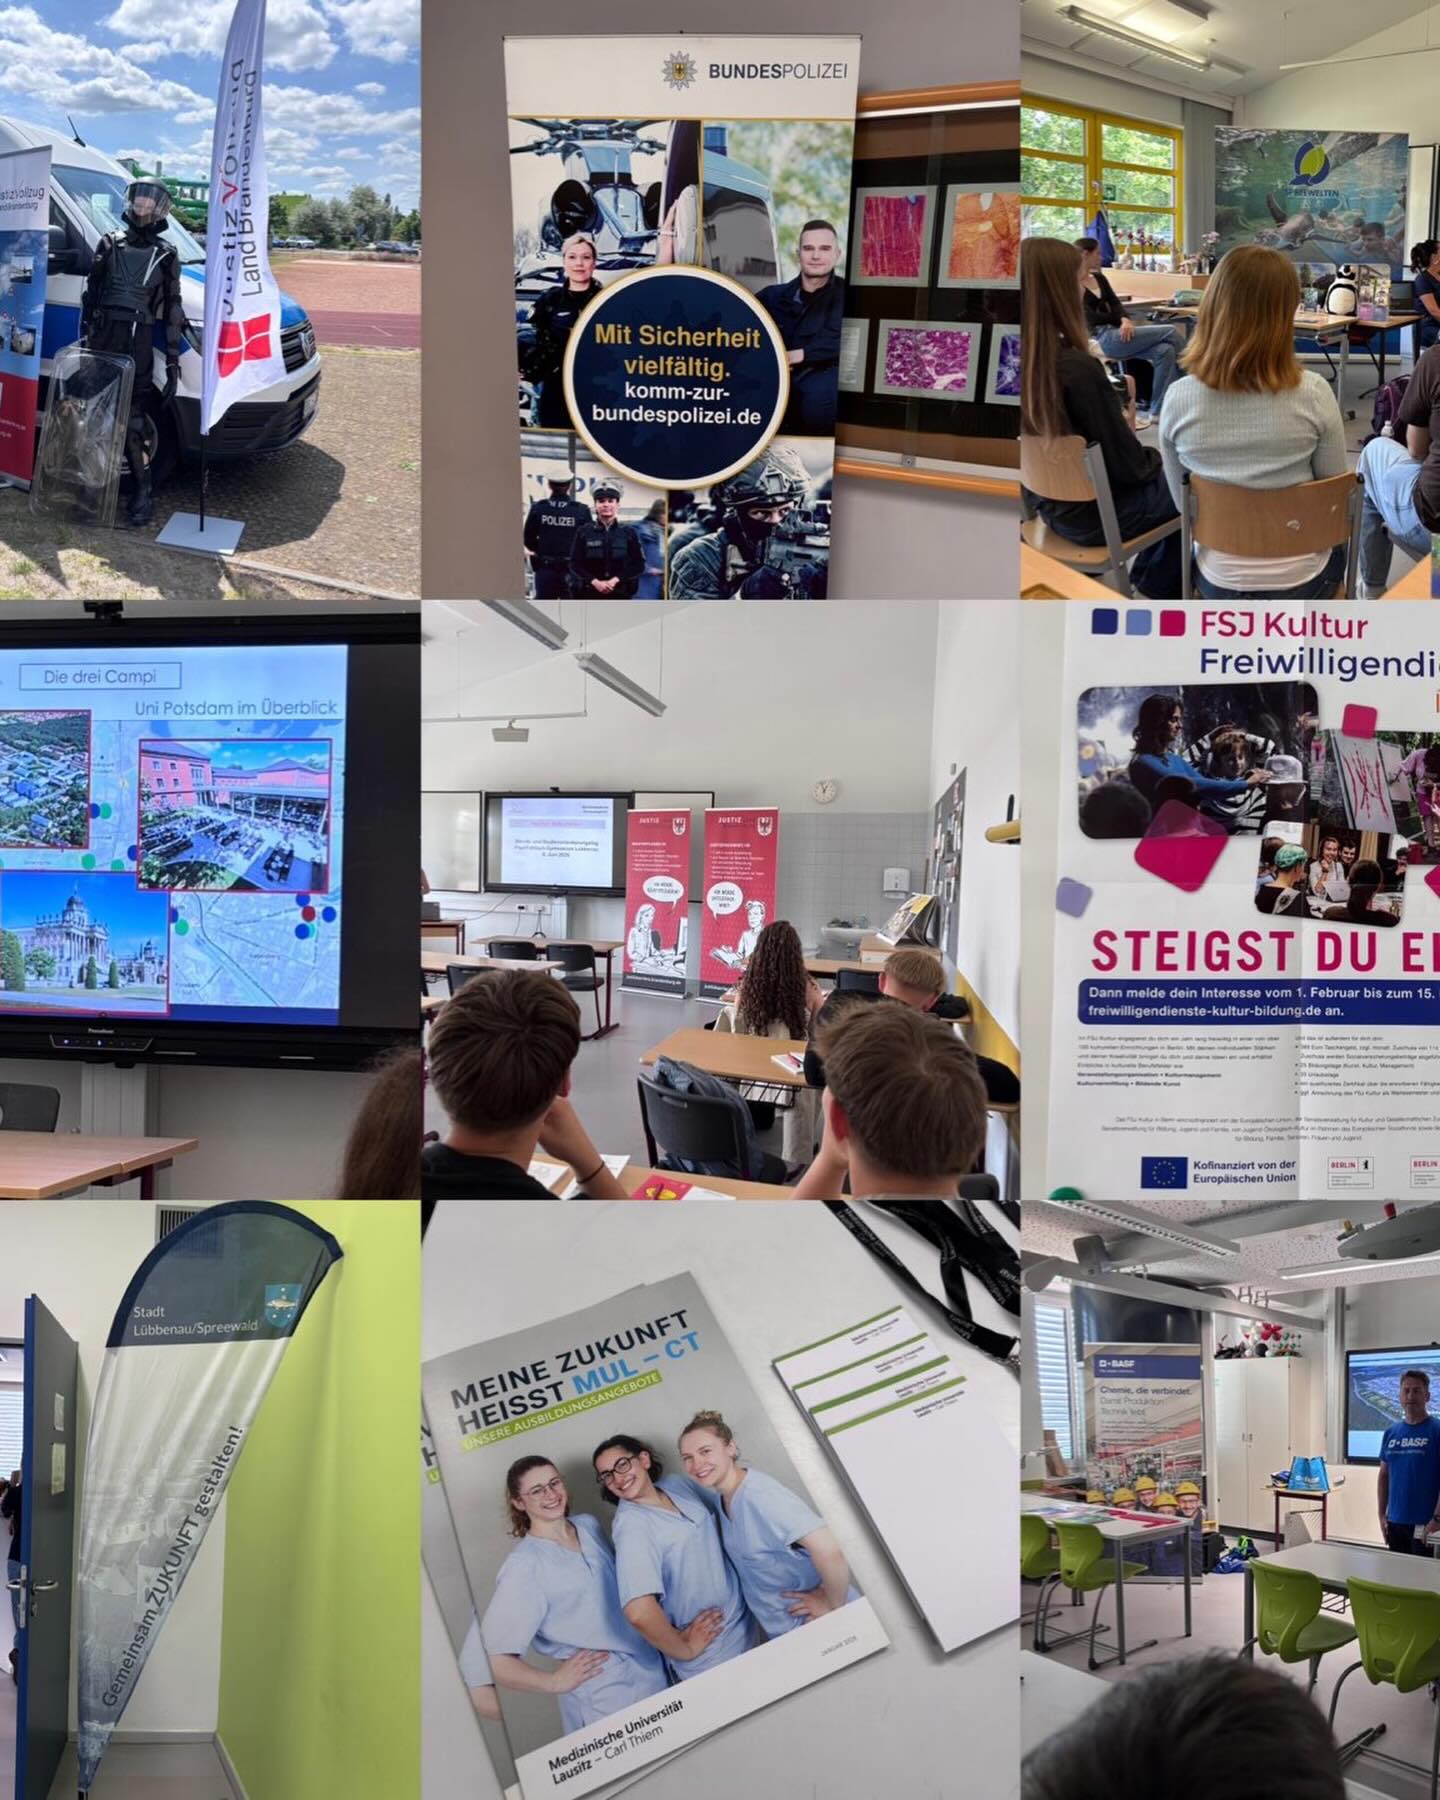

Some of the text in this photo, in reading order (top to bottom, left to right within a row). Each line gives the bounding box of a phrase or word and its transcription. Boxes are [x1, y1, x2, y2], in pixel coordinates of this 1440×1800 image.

[709, 63, 848, 79] BUNDESPOLIZEI
[219, 58, 245, 316] JustizVog
[241, 241, 263, 297] Land
[595, 323, 761, 349] Mit Sicherheit
[624, 356, 731, 382] vielfältig.
[625, 381, 730, 401] komm-zur-
[592, 404, 762, 427] bundespolizei.de
[541, 515, 575, 527] POLIZEI
[1201, 611, 1369, 639] FSJ Kultur
[1201, 647, 1440, 682] Freiwilligendi
[44, 668, 157, 686] Die drei Campi
[136, 698, 338, 716] Uni Potsdam im Überblick
[718, 816, 742, 824] JUSTIZ
[1091, 930, 1294, 972] STEIGST
[1317, 931, 1377, 972] DU
[1089, 986, 1436, 1000] Dann melde dein Interesse vom 1. Februar bis zum 15.
[1088, 1004, 1344, 1018] freiwilligendienste-kultur-bildung.de an.
[1193, 1160, 1296, 1170] Kofinanziert von der
[1331, 1161, 1356, 1169] BERLIN
[1413, 1160, 1438, 1168] BERLIN
[1193, 1172, 1296, 1184] Europäischen Union
[133, 1306, 165, 1318] Stadt
[133, 1320, 259, 1337] Lübbenau/Spreewald
[451, 1309, 689, 1410] MEINE ZUKUNFT
[1111, 1360, 1135, 1368] BASF
[457, 1381, 564, 1436] HEISST
[572, 1358, 638, 1395] MUL
[664, 1331, 700, 1360] CT
[1100, 1386, 1135, 1395] Chemie,
[1151, 1387, 1193, 1396] verbindet.
[464, 1371, 660, 1450] UNSERE AUSBILDUNGSANGEBOTE
[1401, 1437, 1429, 1447] BASF
[102, 1425, 244, 1708] Gemeinsam ZUKUNFT gestalten!
[548, 1699, 684, 1771] Medizinische Universität
[552, 1758, 593, 1785] Lausitz
[604, 1743, 628, 1760] Carl
[628, 1725, 664, 1750] Thiem
